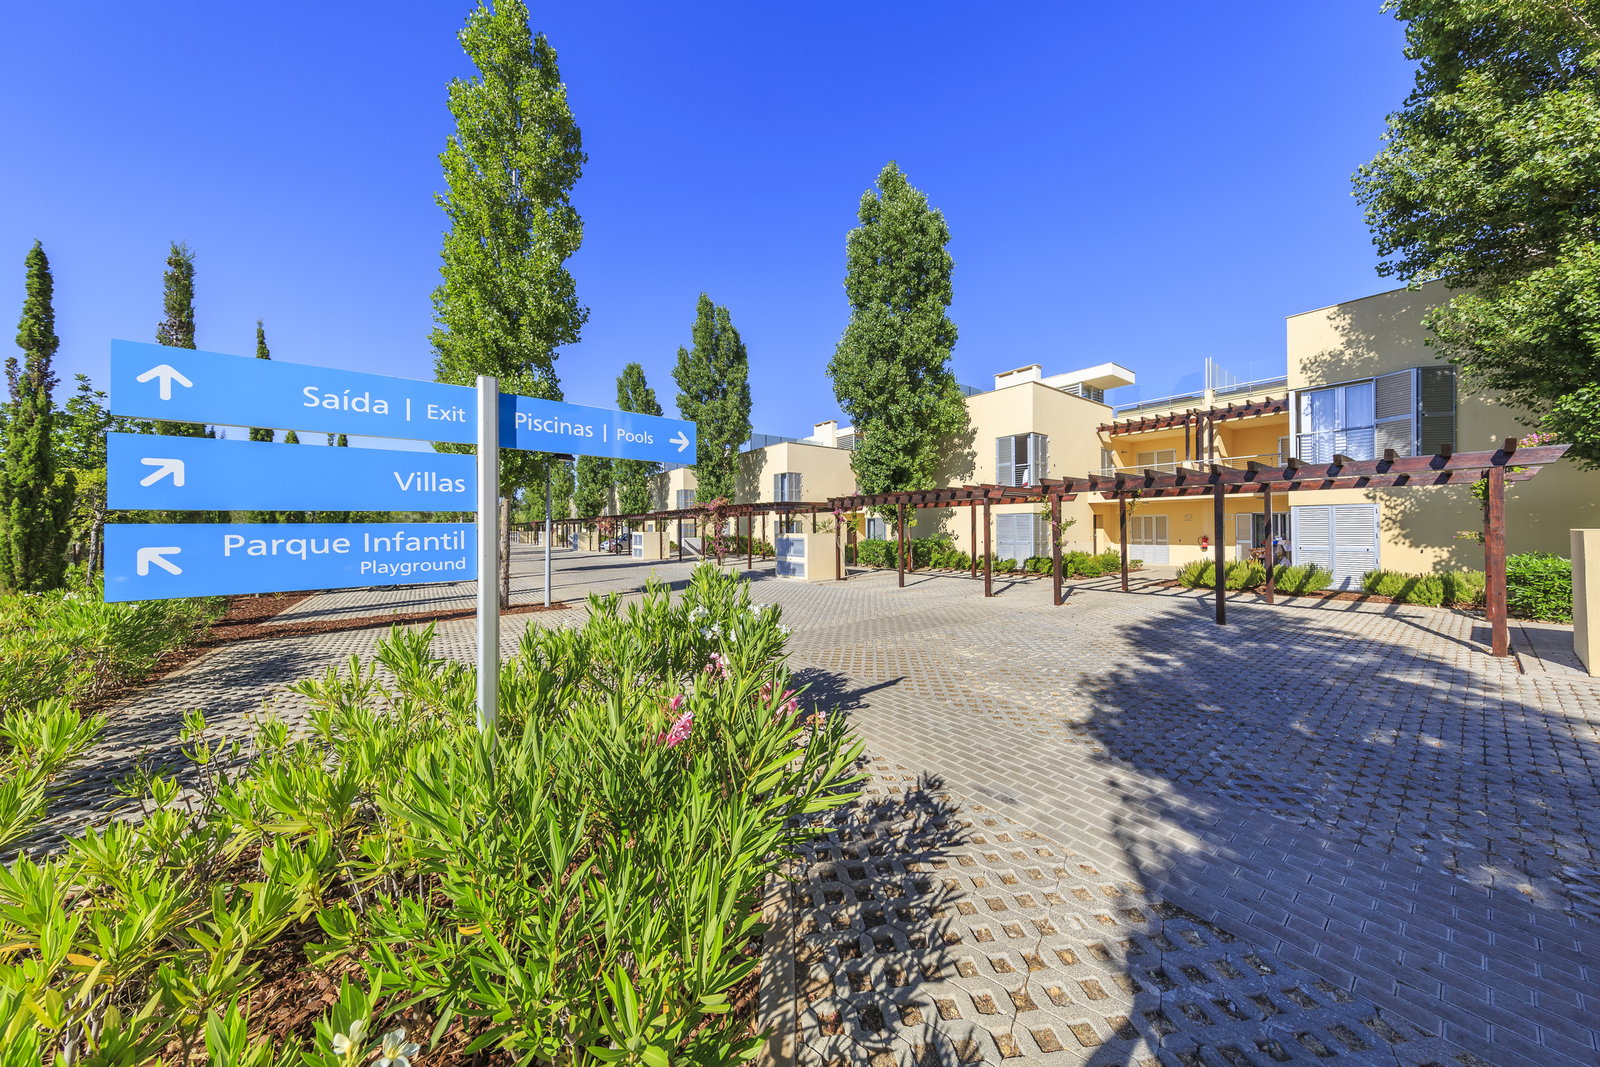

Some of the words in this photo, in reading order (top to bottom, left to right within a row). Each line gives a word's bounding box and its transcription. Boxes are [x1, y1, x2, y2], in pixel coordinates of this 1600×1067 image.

[302, 386, 389, 415] Saída
[426, 403, 467, 424] Exit
[514, 412, 594, 438] Piscinas
[616, 428, 654, 445] Pools
[393, 471, 466, 493] Villas
[223, 534, 351, 561] Parque
[364, 529, 466, 554] Infantil
[360, 556, 466, 577] Playground
